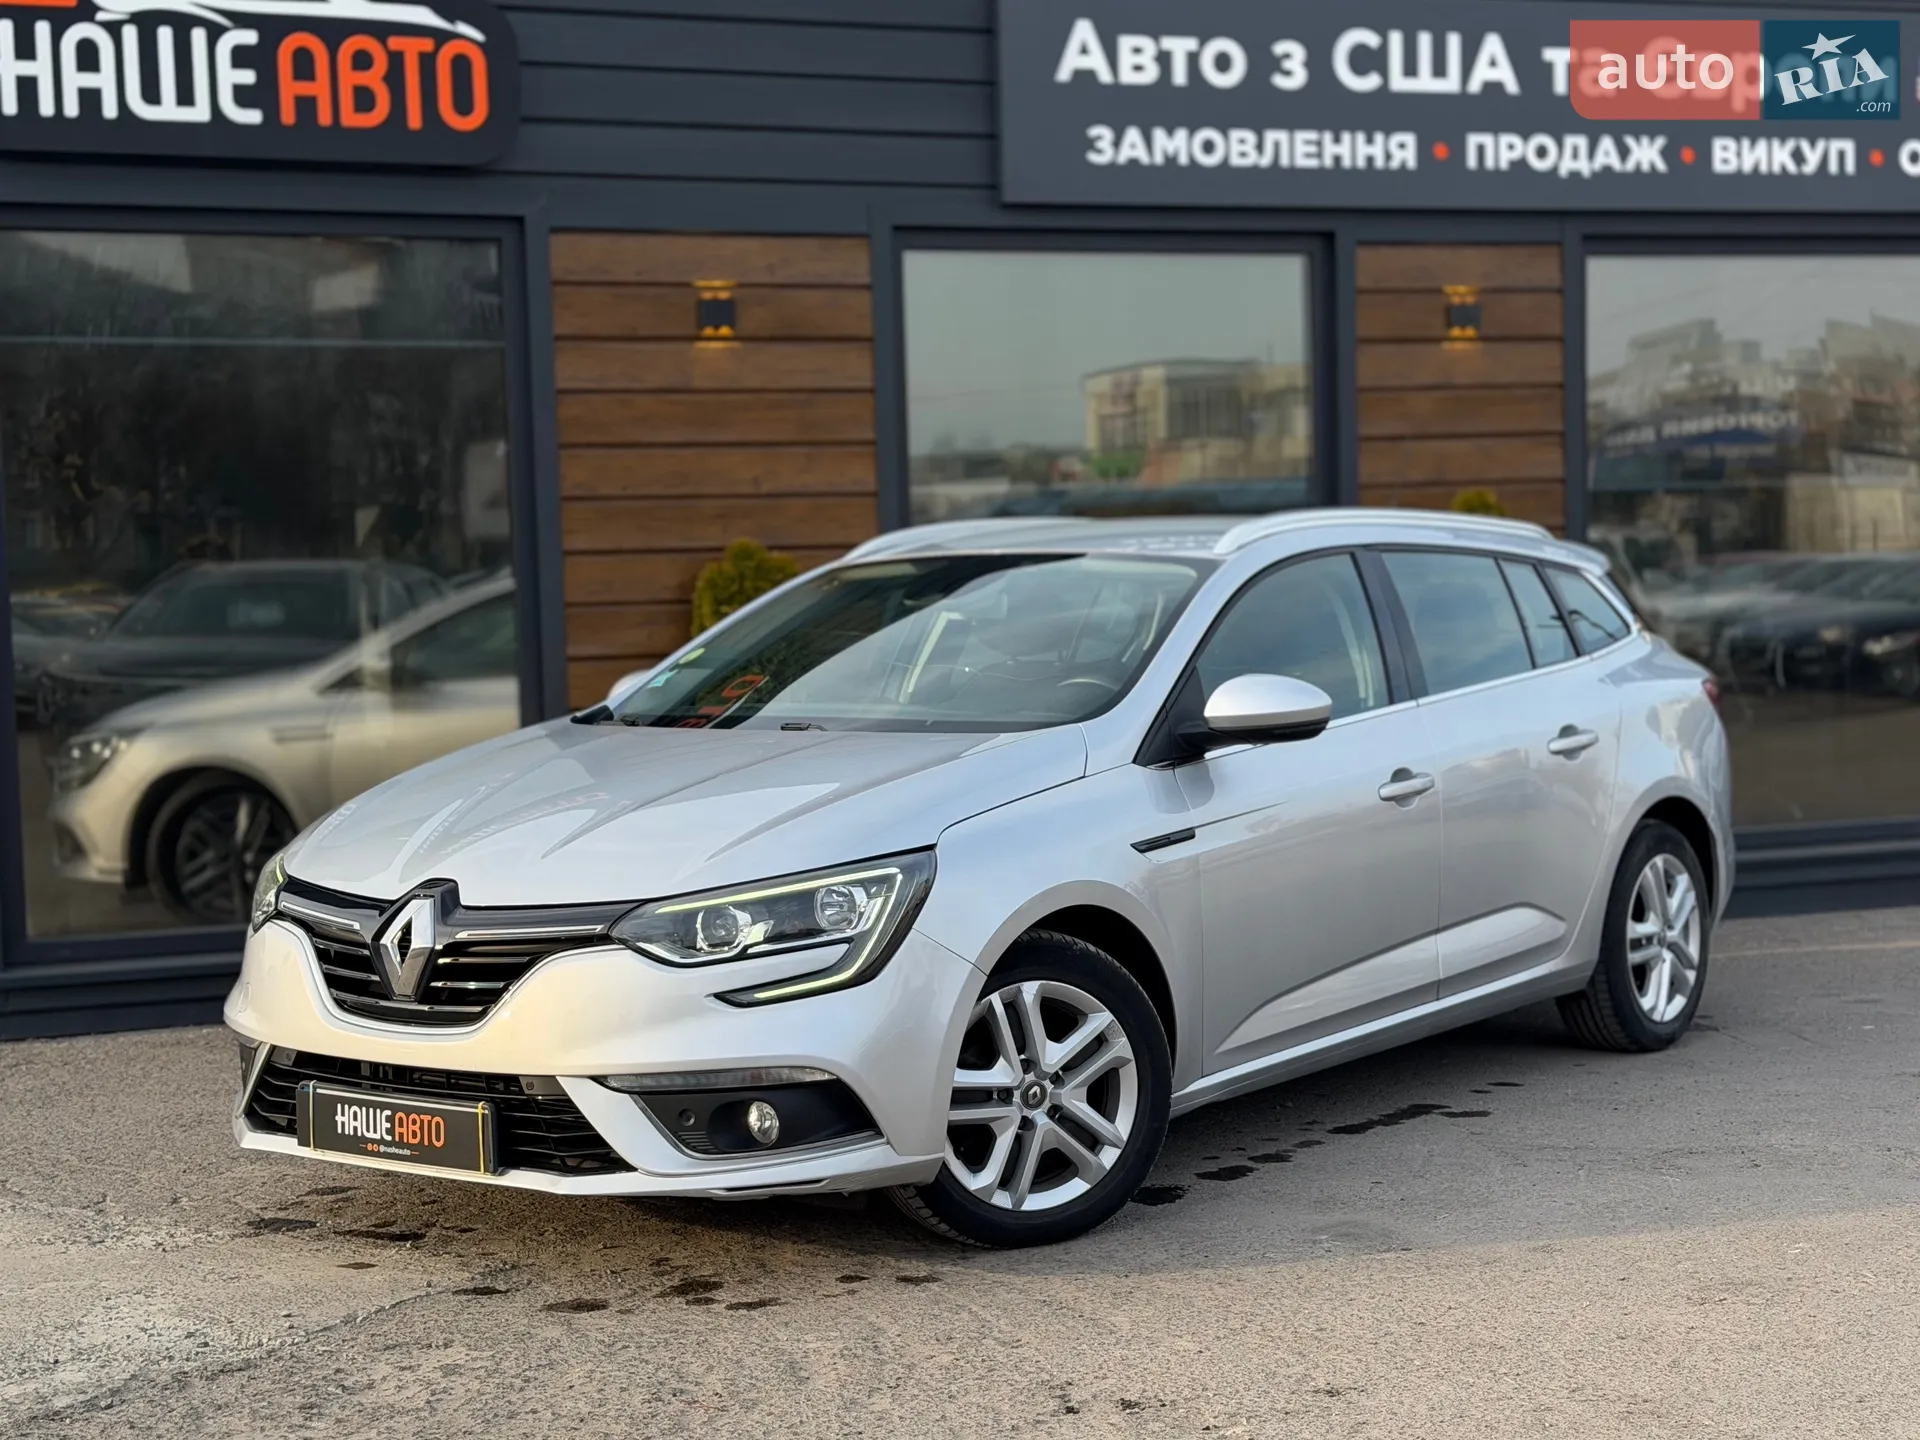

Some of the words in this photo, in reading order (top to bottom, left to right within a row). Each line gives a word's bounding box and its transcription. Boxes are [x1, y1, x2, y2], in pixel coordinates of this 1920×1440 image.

[0, 20, 262, 124] НАШЕ
[278, 32, 488, 132] АВТО
[1055, 18, 1247, 89] Авто
[1271, 39, 1308, 91] з
[1332, 27, 1522, 95] США
[1086, 125, 1418, 170] ЗАМОВЛЕННЯ
[1465, 133, 1668, 178] ПРОДАЖ
[1711, 136, 1856, 176] ВИКУП
[335, 1103, 392, 1141] НАШЕ
[394, 1111, 445, 1148] АВТО
